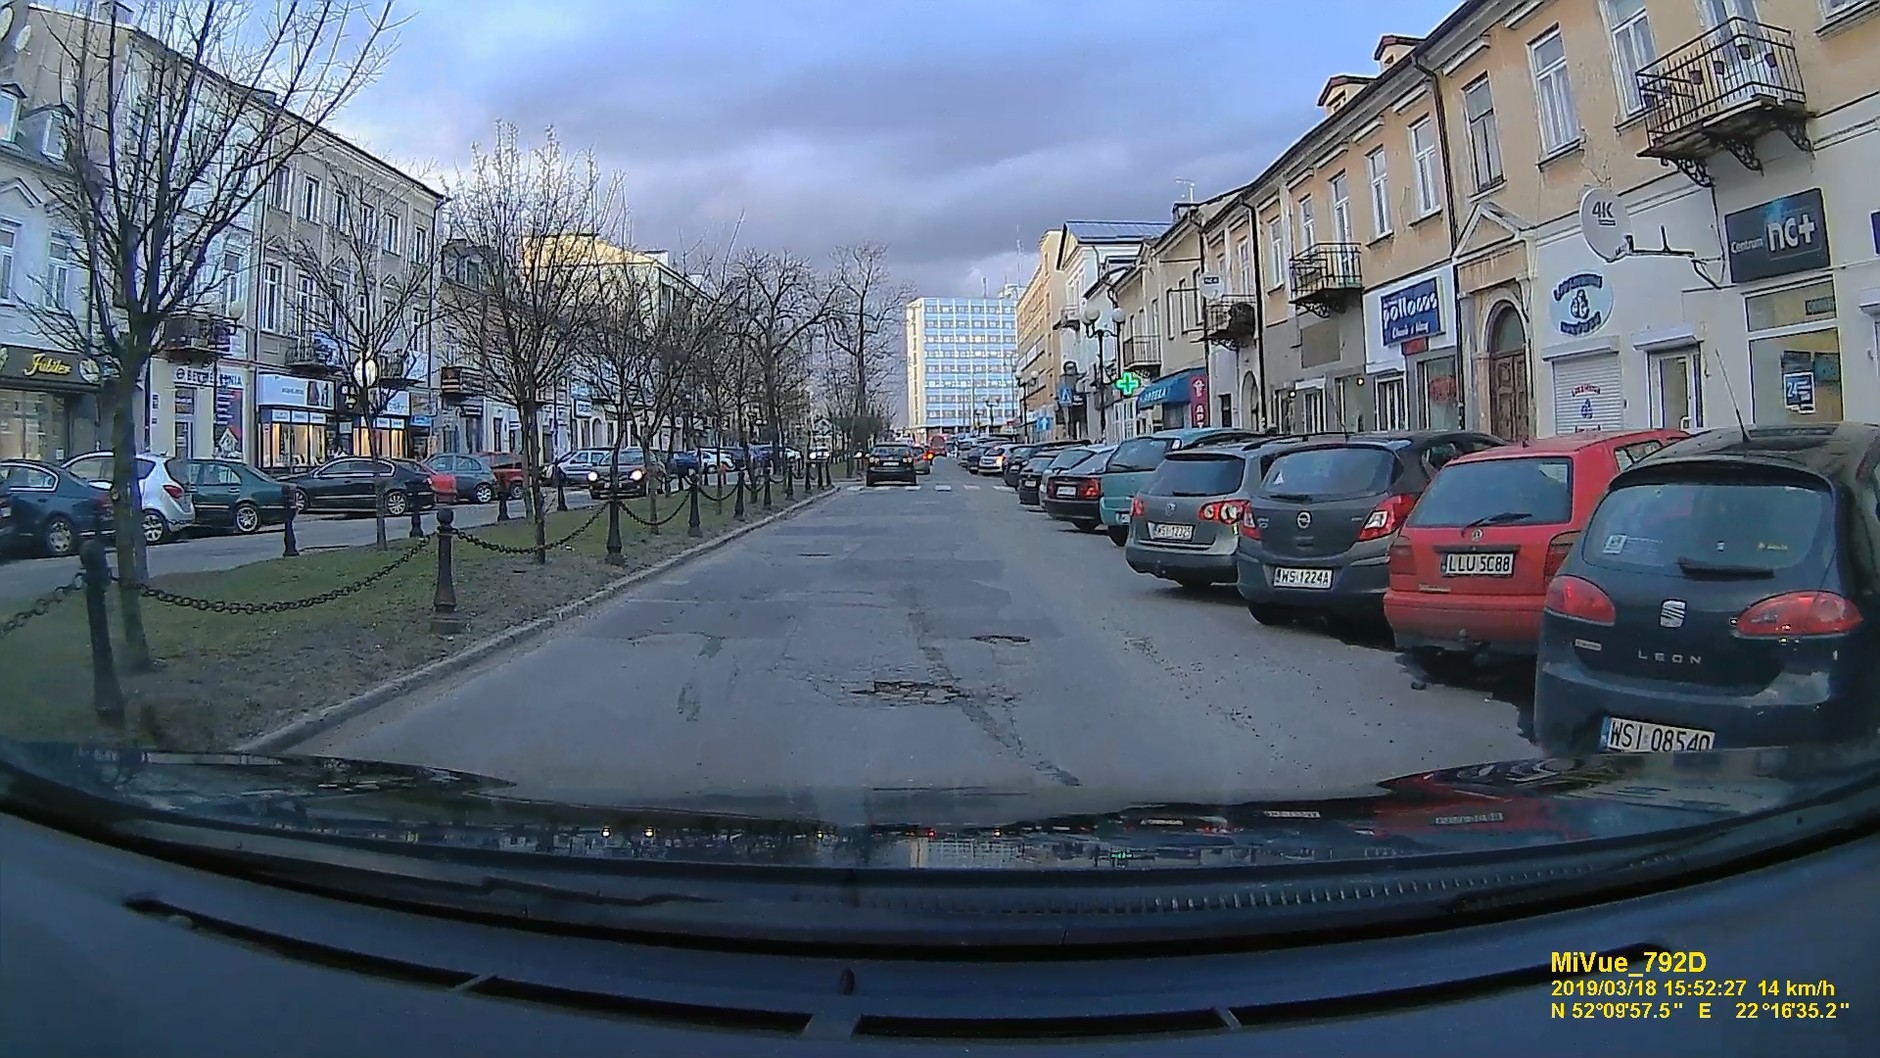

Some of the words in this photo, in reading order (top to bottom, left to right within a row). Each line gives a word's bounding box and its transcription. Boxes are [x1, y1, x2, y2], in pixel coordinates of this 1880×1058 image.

[1592, 201, 1613, 218] 4K
[1731, 238, 1763, 253] Centrum
[1767, 214, 1815, 252] nc+
[1448, 555, 1475, 571] LLU
[1479, 556, 1510, 571] 5C88
[1300, 570, 1329, 583] 1224A
[1638, 648, 1702, 664] LEON
[1610, 720, 1643, 749] WSI
[1651, 728, 1711, 752] 08540
